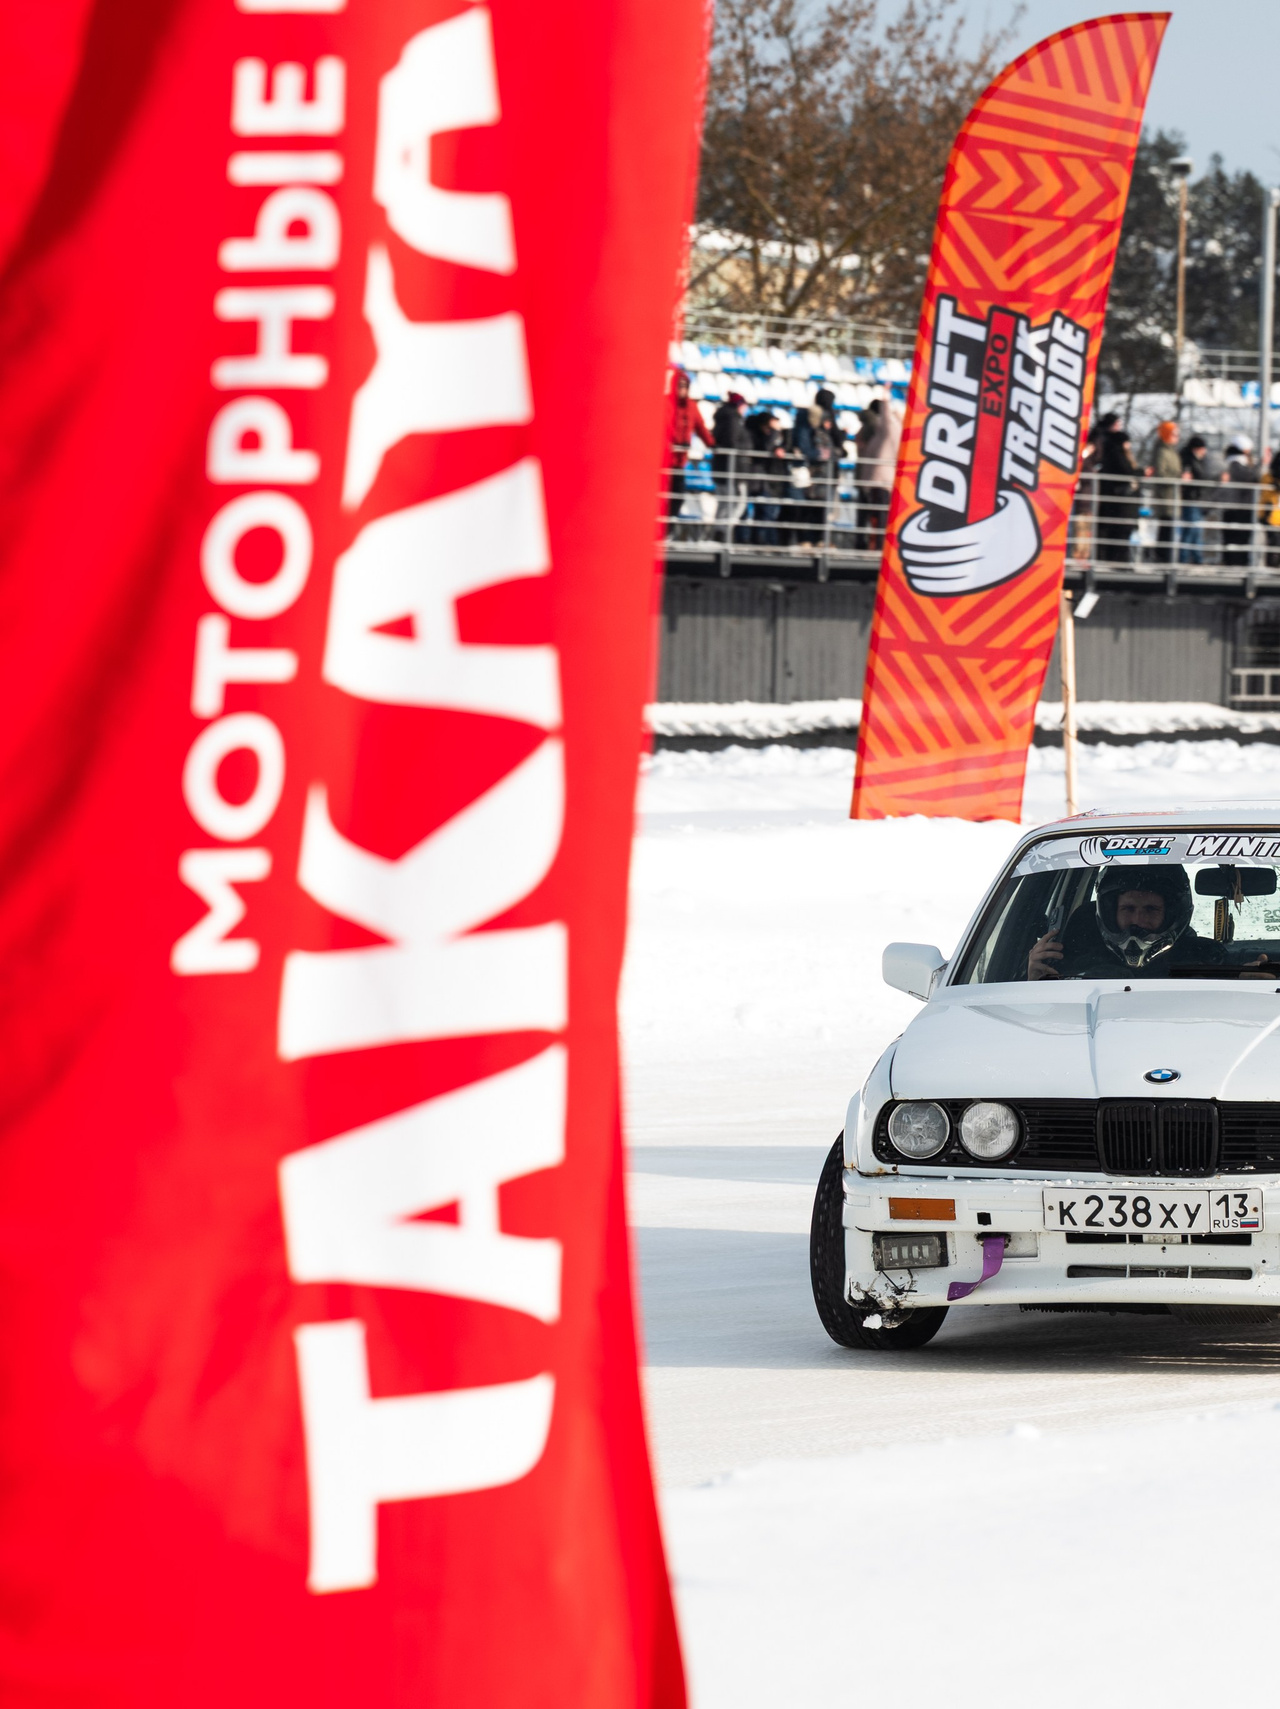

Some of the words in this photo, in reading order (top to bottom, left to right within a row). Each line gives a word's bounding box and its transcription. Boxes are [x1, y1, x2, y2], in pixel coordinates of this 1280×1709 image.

[917, 297, 988, 514] DRIFT
[983, 333, 1009, 418] EXPO
[1001, 316, 1050, 488] TRACK
[1039, 315, 1086, 471] MODE
[172, 57, 346, 976] МОТОРНЫЕ
[278, 0, 569, 1595] TAKAYA
[1106, 837, 1176, 850] DRIFT
[1213, 1219, 1239, 1228] RUS
[1215, 1193, 1248, 1218] 13
